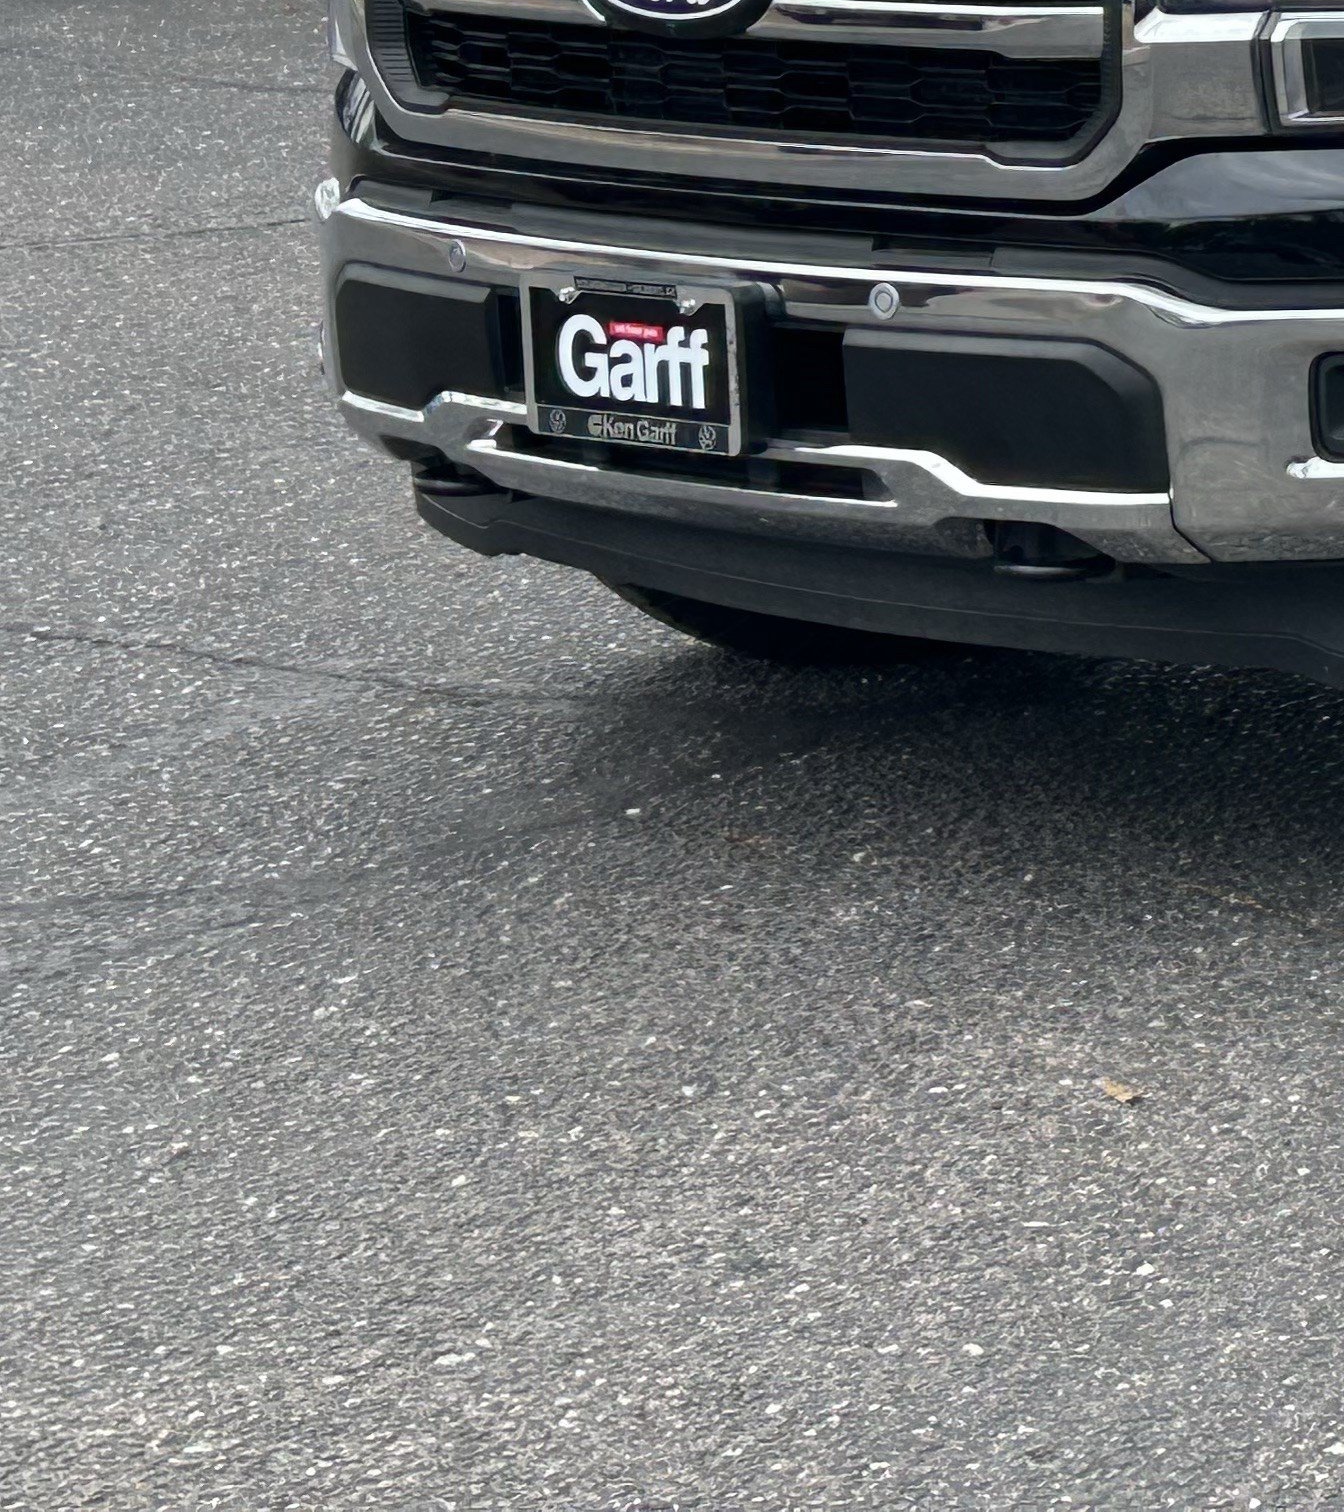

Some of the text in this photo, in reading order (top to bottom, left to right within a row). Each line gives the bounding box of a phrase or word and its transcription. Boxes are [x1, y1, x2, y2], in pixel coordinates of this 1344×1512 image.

[558, 313, 710, 410] Garff
[602, 414, 677, 446] Ken Garff
